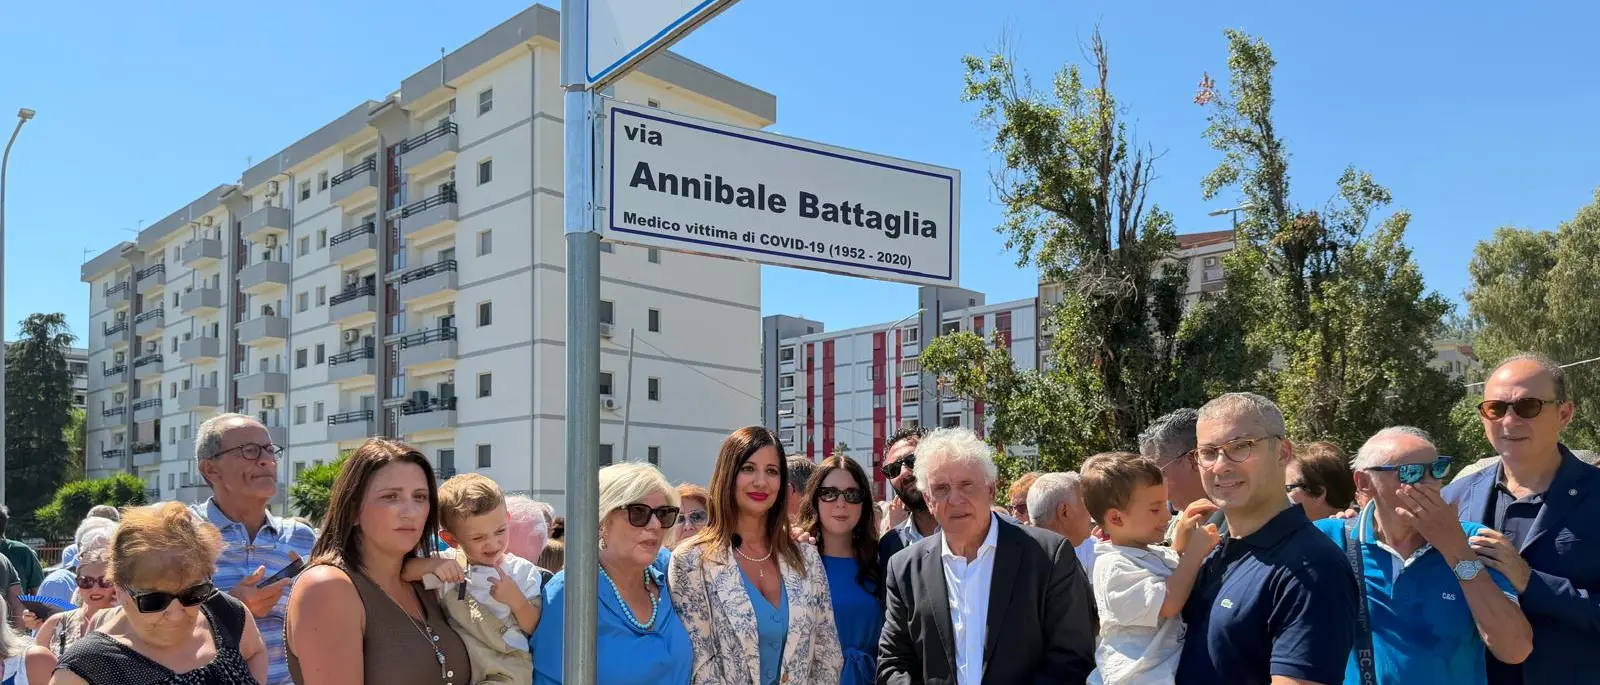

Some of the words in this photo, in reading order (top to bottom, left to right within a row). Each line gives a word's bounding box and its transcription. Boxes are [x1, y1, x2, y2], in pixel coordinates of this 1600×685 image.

[624, 124, 663, 146] via
[629, 161, 787, 213] Annibale
[799, 191, 937, 238] Battaglia
[623, 211, 680, 231] Medico
[686, 223, 737, 241] vittima
[743, 231, 755, 243] di
[760, 233, 825, 253] COVID-19
[829, 243, 865, 259] (1952
[877, 251, 911, 268] 2020)
